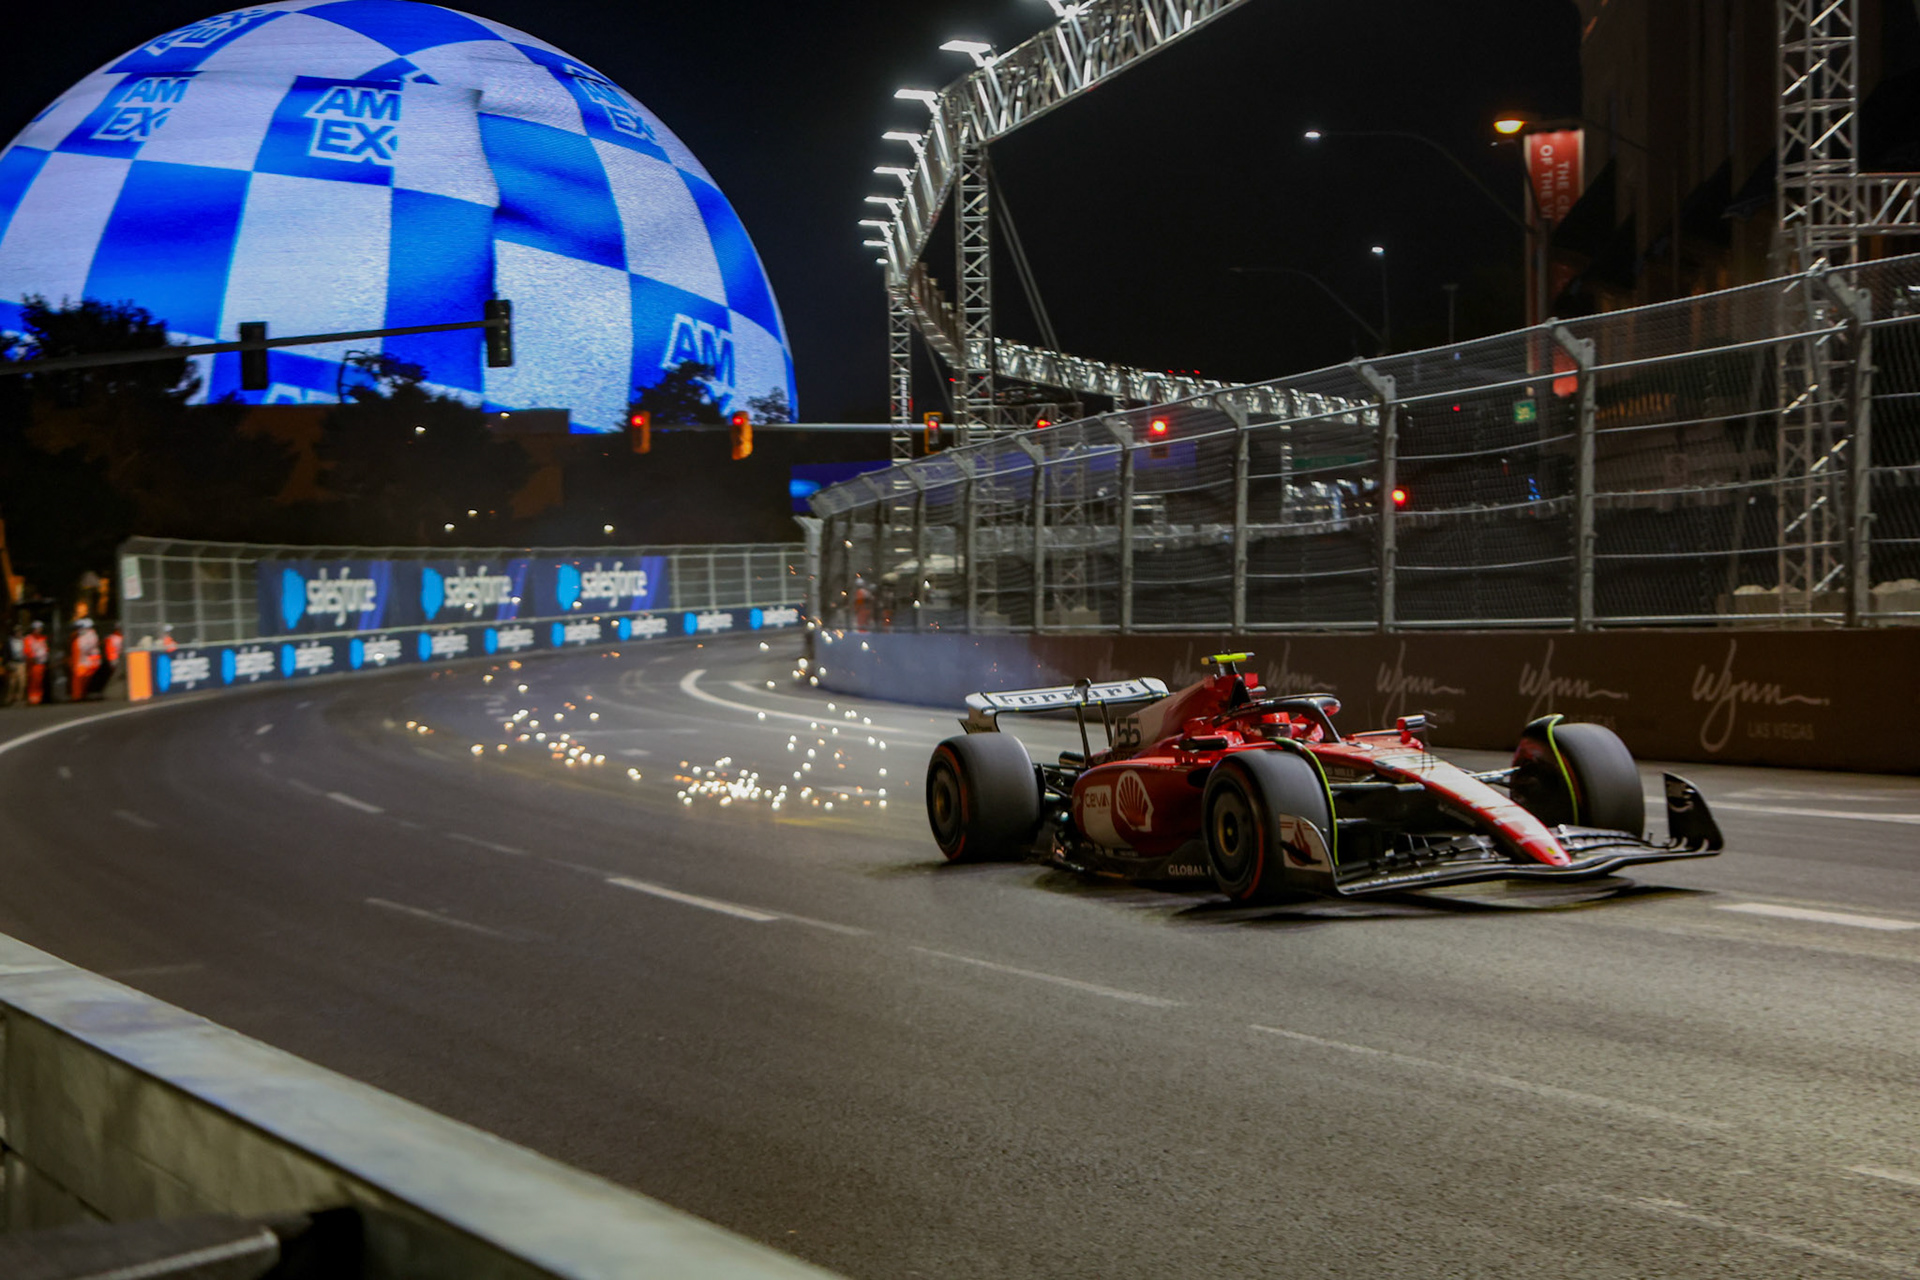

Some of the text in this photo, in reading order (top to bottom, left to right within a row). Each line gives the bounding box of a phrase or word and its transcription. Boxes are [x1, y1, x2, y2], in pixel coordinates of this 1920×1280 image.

[121, 78, 191, 104] AM
[318, 88, 400, 120] AM
[100, 106, 170, 138] EX
[313, 118, 398, 161] EX
[1539, 144, 1553, 165] OF
[1540, 170, 1553, 200] THE
[1556, 160, 1570, 190] THE
[666, 317, 736, 389] AM
[997, 683, 1140, 705] Ferrari
[1376, 639, 1466, 728] Wynn
[1518, 638, 1630, 720] Wynn
[1691, 638, 1831, 752] Wynn
[1117, 718, 1142, 748] 55
[1168, 864, 1206, 876] GLOBAL
